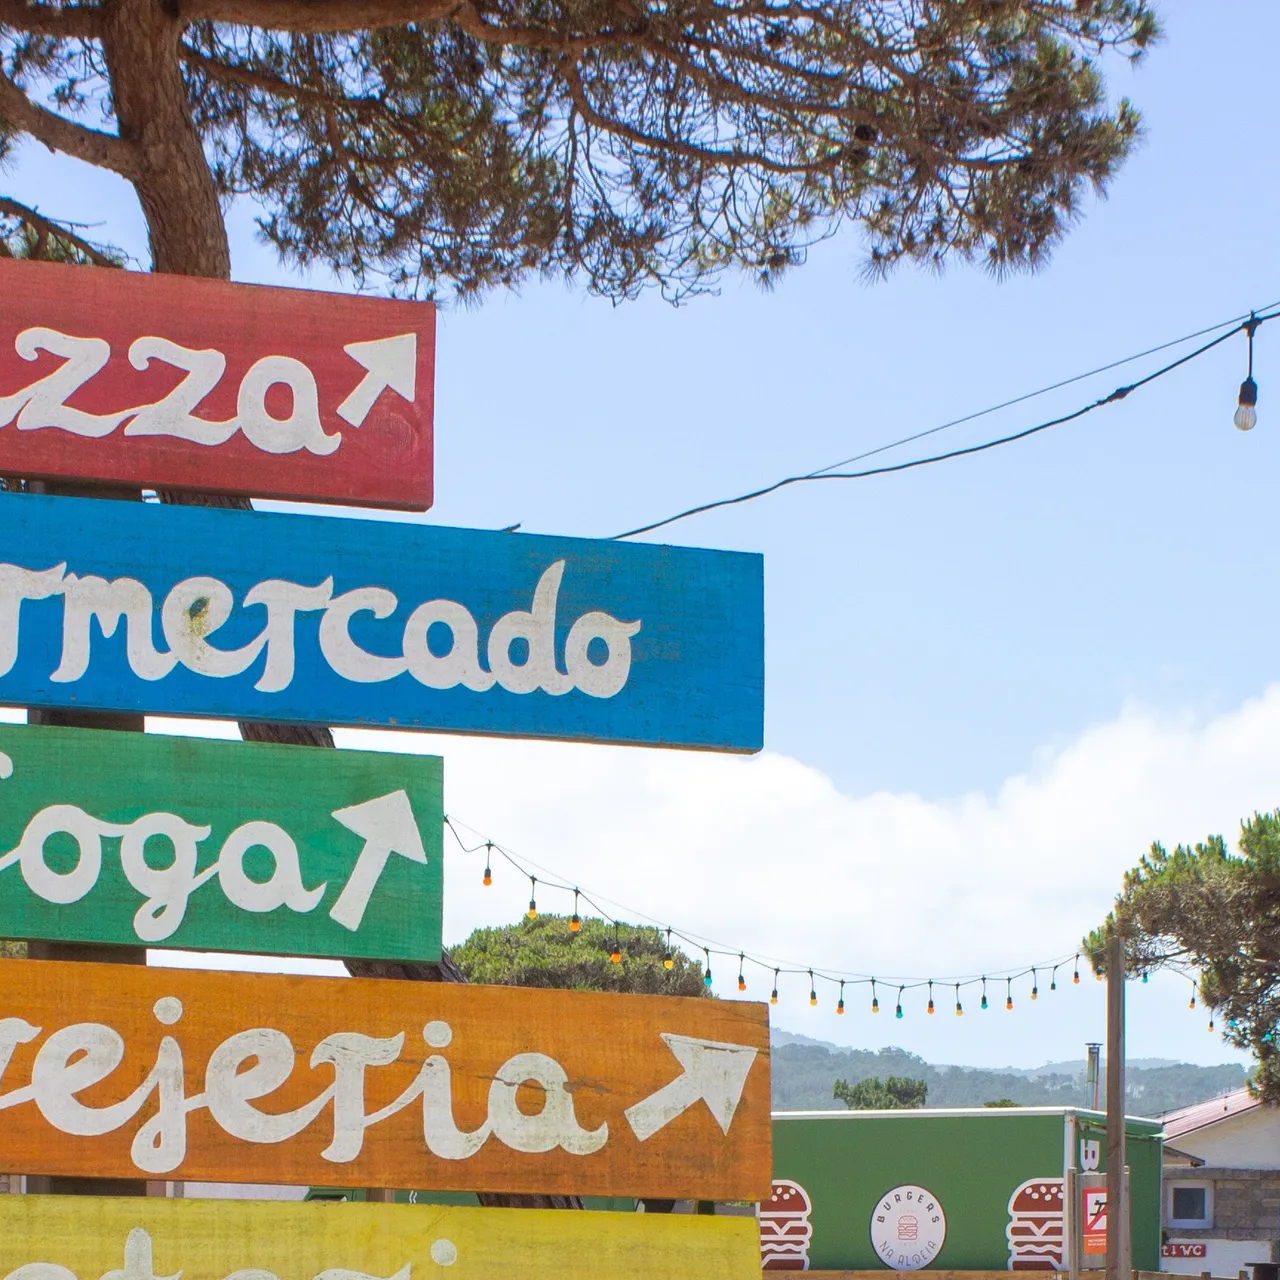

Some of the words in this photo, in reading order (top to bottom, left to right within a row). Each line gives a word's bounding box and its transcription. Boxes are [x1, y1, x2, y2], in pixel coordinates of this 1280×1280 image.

[877, 1191, 940, 1223] BURGERS
[880, 1240, 895, 1260] NA
[897, 1240, 937, 1267] ALDEIA
[1180, 1244, 1202, 1256] WC
